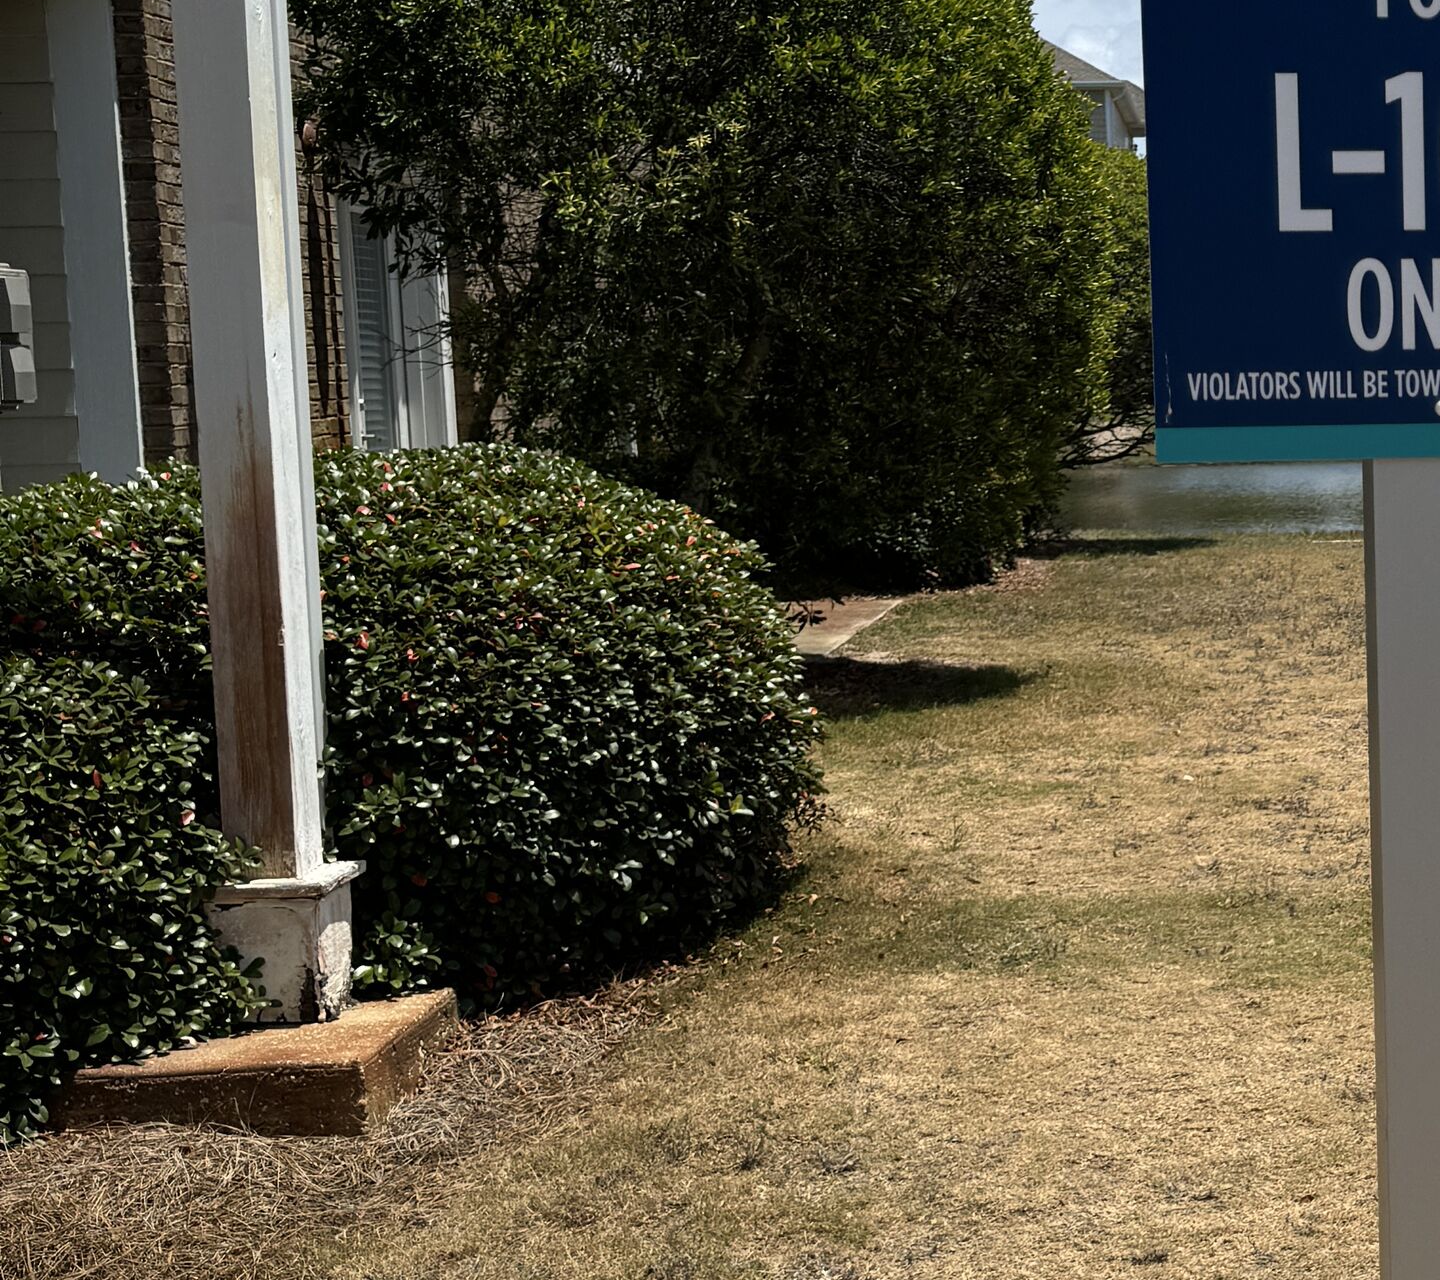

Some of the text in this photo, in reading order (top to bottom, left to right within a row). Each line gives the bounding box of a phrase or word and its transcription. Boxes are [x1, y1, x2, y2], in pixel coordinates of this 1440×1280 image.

[1188, 372, 1300, 400] VIOLATORS
[1307, 371, 1357, 398] WILL
[1364, 371, 1388, 397] BE
